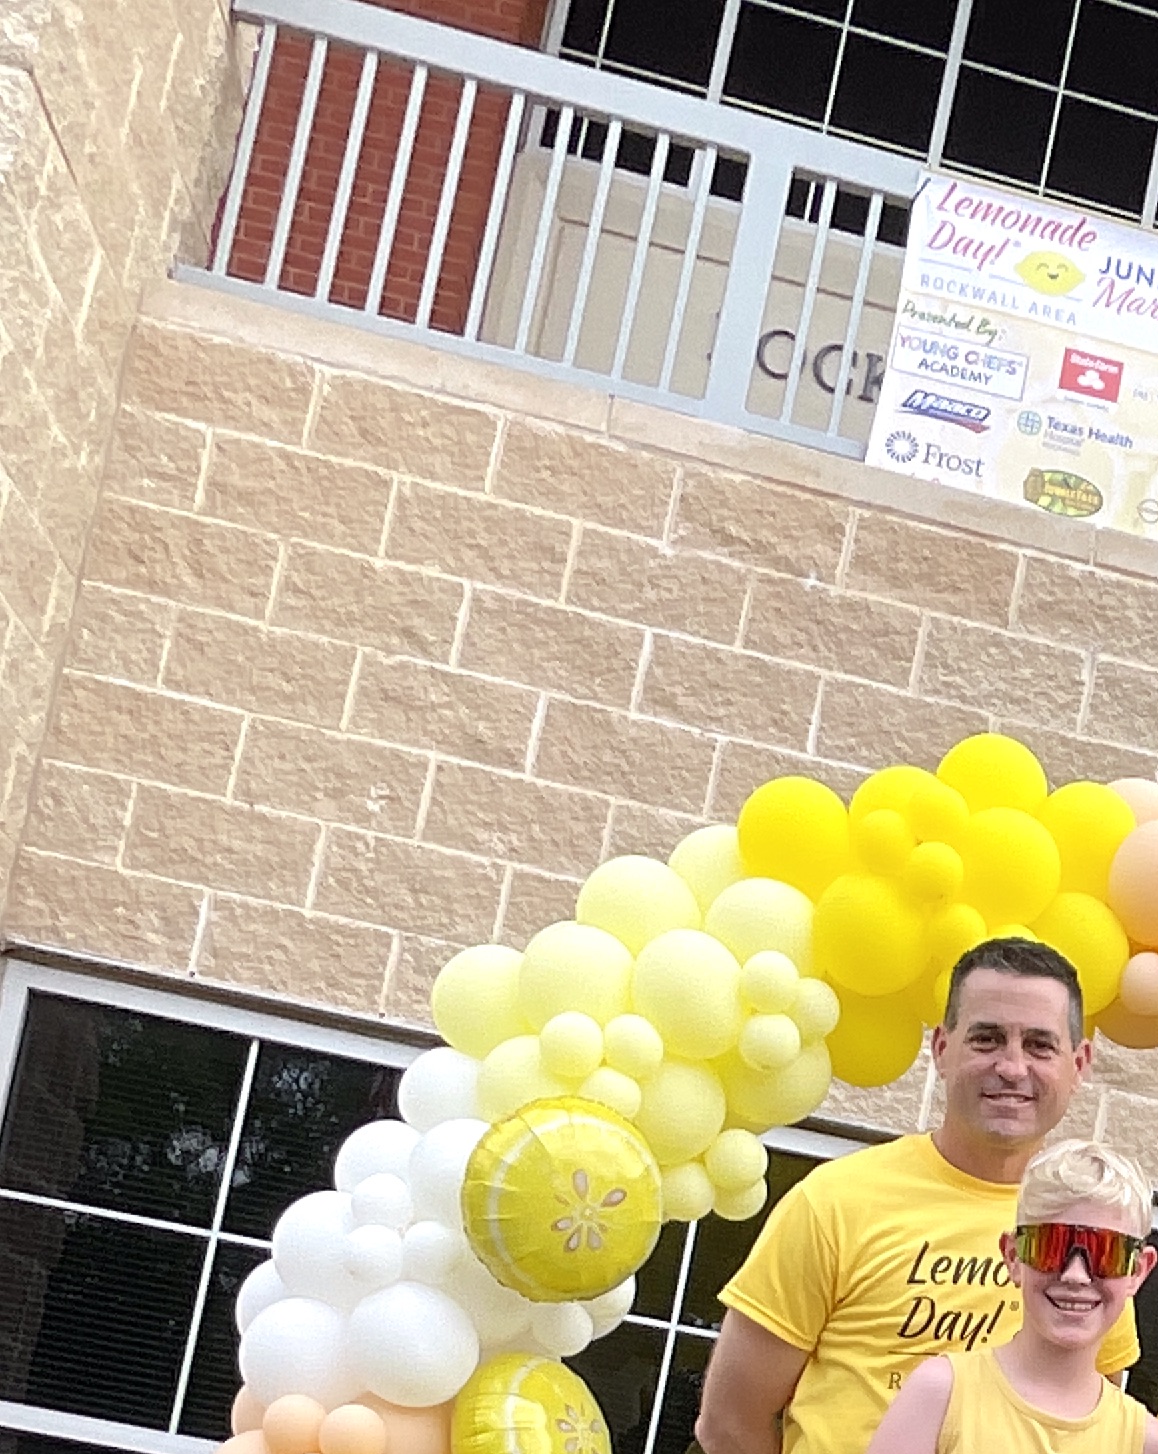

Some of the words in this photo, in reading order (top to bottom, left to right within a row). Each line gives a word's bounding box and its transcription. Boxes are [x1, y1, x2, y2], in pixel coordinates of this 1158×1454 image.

[936, 182, 1098, 251] Lemonade
[928, 220, 1011, 271] Day!
[902, 299, 975, 332] Presented
[920, 273, 1018, 309] ROCKWALL
[1028, 302, 1078, 327] AREA
[899, 332, 959, 361] YOUNG
[917, 358, 993, 386] ACADEMY
[1047, 415, 1084, 437] Texas
[1088, 425, 1134, 450] Health
[921, 443, 985, 478] Frost
[897, 1297, 1006, 1351] Day!
